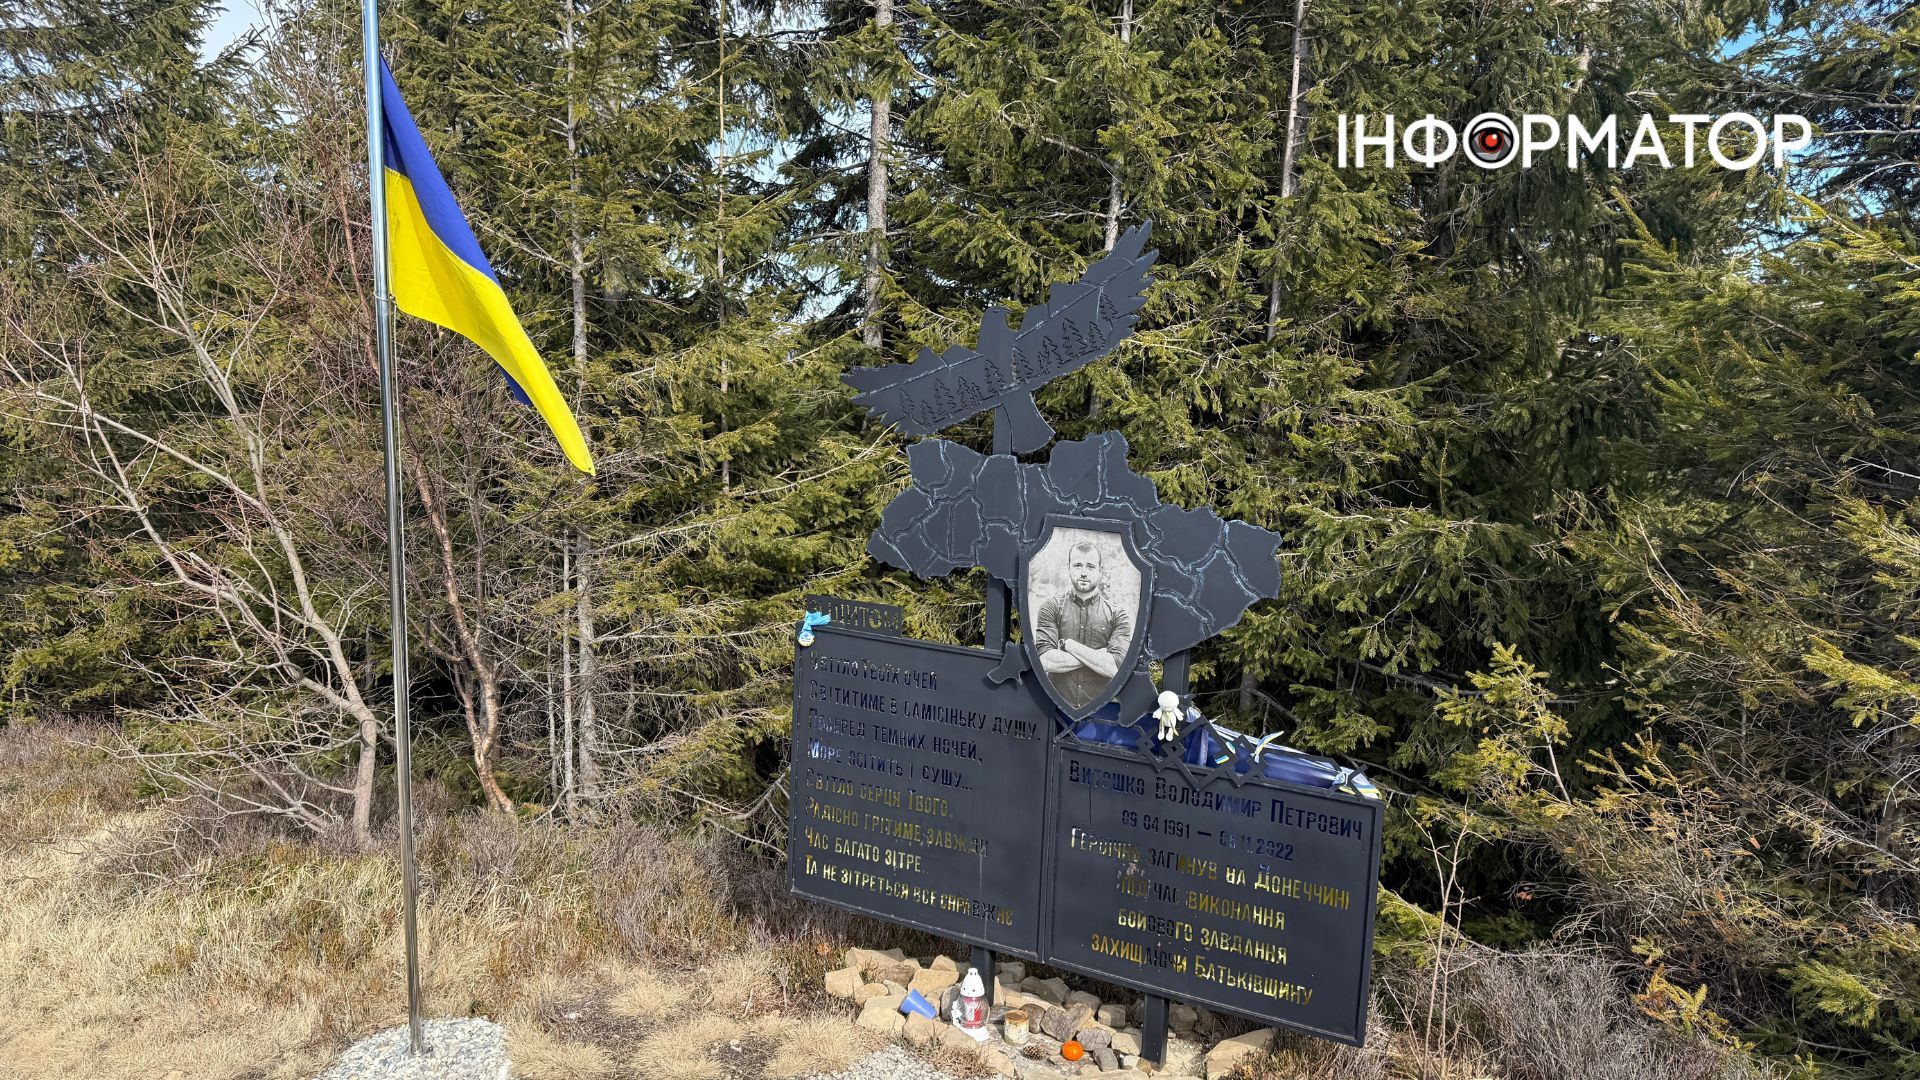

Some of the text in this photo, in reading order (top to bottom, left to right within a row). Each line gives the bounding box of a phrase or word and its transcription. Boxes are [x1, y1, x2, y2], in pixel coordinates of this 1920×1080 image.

[809, 680, 885, 712] СВІТИТИМЕ
[890, 698, 898, 715] В
[903, 701, 987, 730] САМІСІНЬКУ
[873, 724, 926, 751] ТЕМНИХ
[805, 796, 859, 828] РАДІСНО
[1155, 776, 1262, 818] ВОЛОДИМИР
[1270, 799, 1363, 840] ПЕТРОВИЧ
[804, 825, 829, 850] ЧАС
[834, 838, 880, 863] БАГАТО
[804, 854, 818, 876] ТА
[823, 865, 837, 883] НЕ
[841, 868, 909, 900] ЗІТРЕТЬСЯ
[1226, 865, 1247, 887] НА
[1254, 863, 1350, 911] ДОНЕЧЧИНІ
[1187, 890, 1286, 931] ВИКОНАННЯ
[1118, 908, 1287, 966] БОЙОВОГО ЗАВДАННЯ
[1091, 933, 1313, 1006] ЗАХИЩАЮЧИ БАТЬКІВЩИНУ
